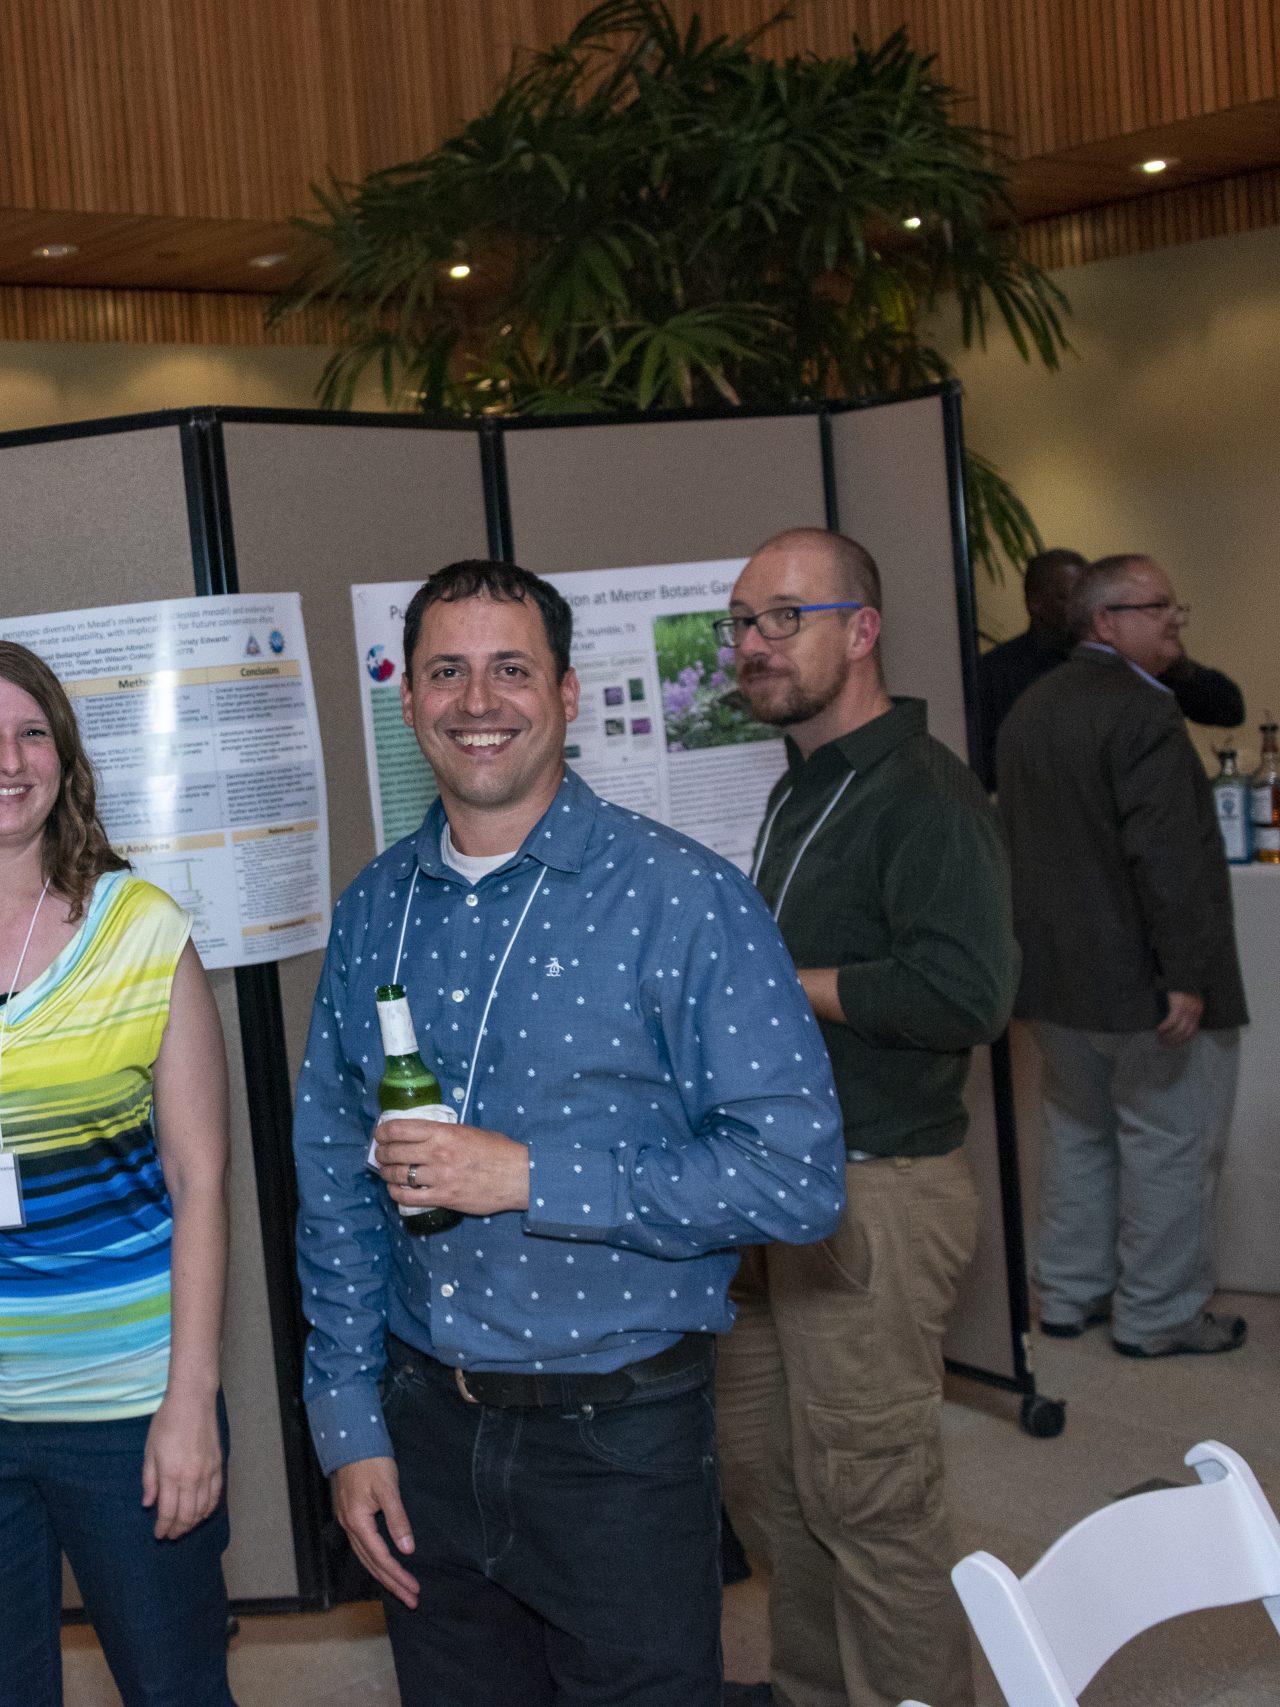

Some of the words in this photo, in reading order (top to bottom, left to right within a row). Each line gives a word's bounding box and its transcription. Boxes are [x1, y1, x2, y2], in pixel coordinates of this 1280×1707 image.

[594, 593, 607, 604] at
[611, 590, 656, 602] Mercer
[660, 585, 707, 597] Botanic
[42, 624, 75, 634] diversity
[76, 621, 85, 629] in
[88, 617, 116, 629] Mead's
[118, 614, 157, 625] milkweed
[108, 627, 125, 636] with
[179, 622, 188, 630] for
[191, 620, 215, 629] future
